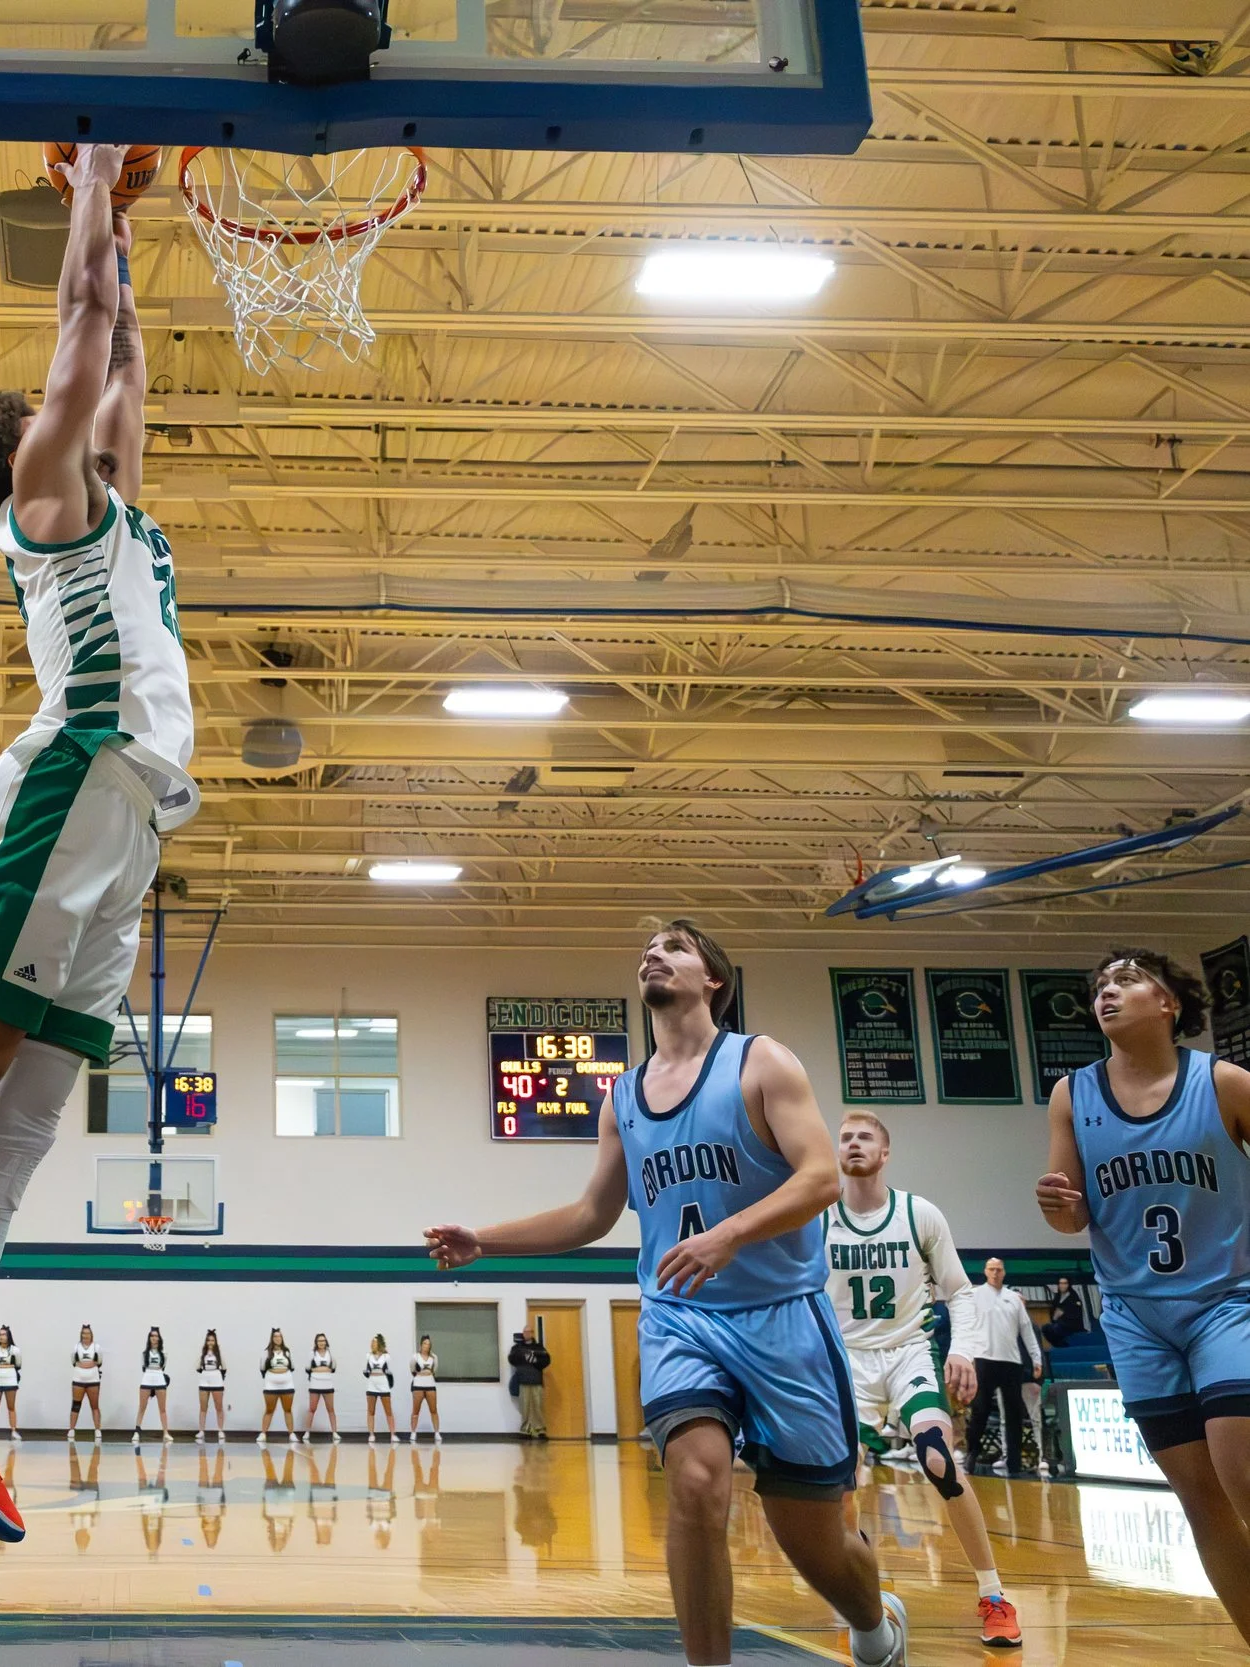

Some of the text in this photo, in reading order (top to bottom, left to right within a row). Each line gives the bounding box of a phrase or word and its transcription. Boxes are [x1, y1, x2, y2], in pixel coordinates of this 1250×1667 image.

[496, 1002, 618, 1028] ENDICOTT
[536, 1034, 593, 1060] 16:38
[500, 1061, 625, 1074] GULLS GORDON
[174, 1076, 214, 1093] 16:38
[503, 1075, 533, 1098] 40
[555, 1077, 569, 1097] 2
[185, 1092, 207, 1118] 16
[497, 1101, 590, 1115] FLS PLYR FOUL
[504, 1116, 517, 1136] 0
[641, 1141, 742, 1209] GORDON
[1094, 1148, 1220, 1201] GORDON
[1143, 1203, 1187, 1276] 3
[830, 1241, 910, 1270] ENDICOTT
[847, 1275, 896, 1320] 12
[1079, 1427, 1097, 1451] TO
[1102, 1428, 1133, 1453] THE
